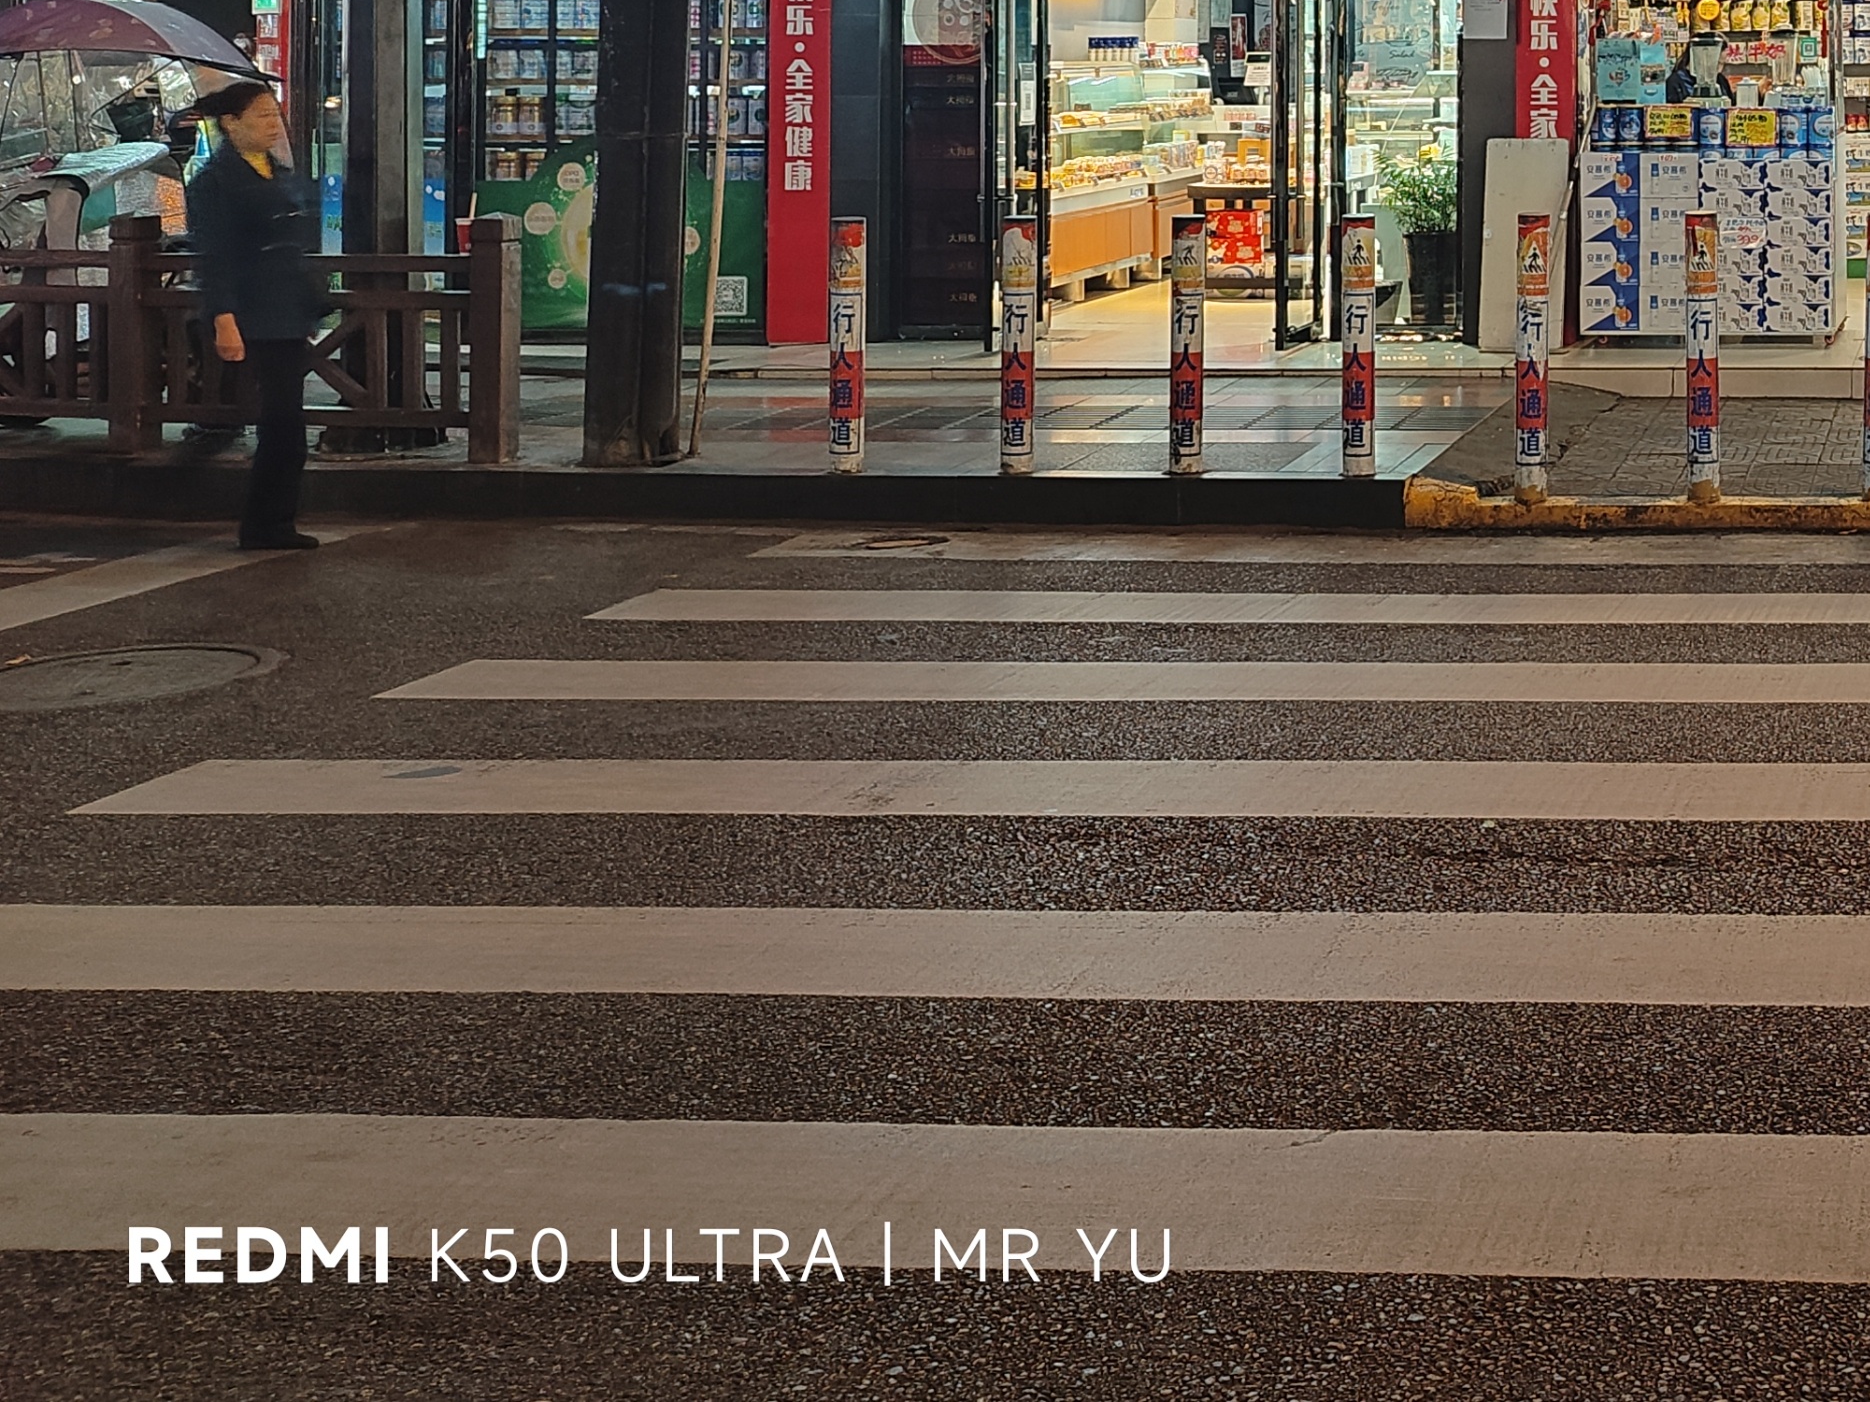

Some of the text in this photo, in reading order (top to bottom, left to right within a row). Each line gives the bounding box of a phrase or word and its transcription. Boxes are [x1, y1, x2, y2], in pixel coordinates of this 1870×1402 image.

[831, 303, 855, 451] 行人通道
[1003, 303, 1030, 448] 行人通道
[1172, 303, 1199, 448] 行人通道
[1343, 303, 1369, 448] 行人通道
[1690, 309, 1714, 455] 行人通道
